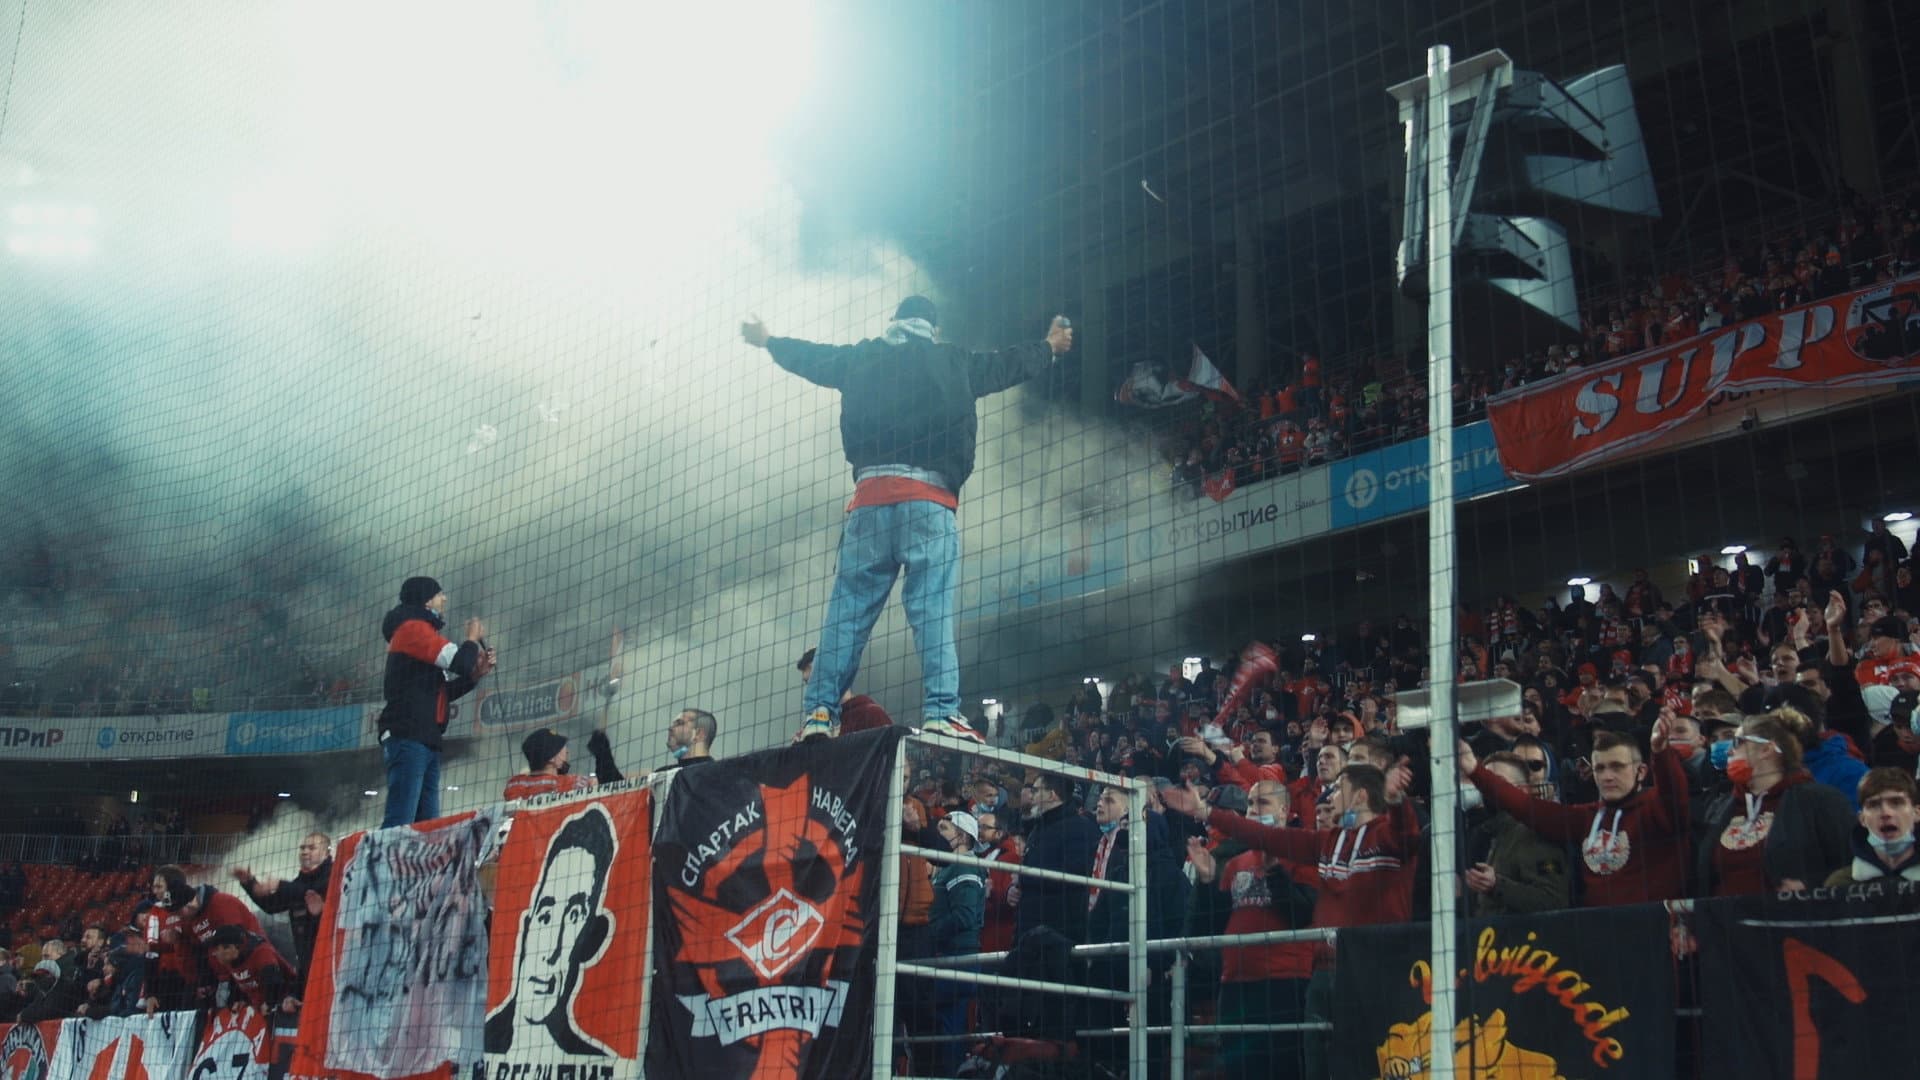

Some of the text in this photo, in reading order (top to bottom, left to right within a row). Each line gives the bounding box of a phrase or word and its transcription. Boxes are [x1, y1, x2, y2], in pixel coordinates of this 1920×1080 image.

[1384, 448, 1500, 490] откыти
[1168, 503, 1278, 545] открытие
[119, 728, 194, 745] открытие
[682, 801, 760, 887] СПАРТАК
[720, 994, 815, 1033] FRATRI
